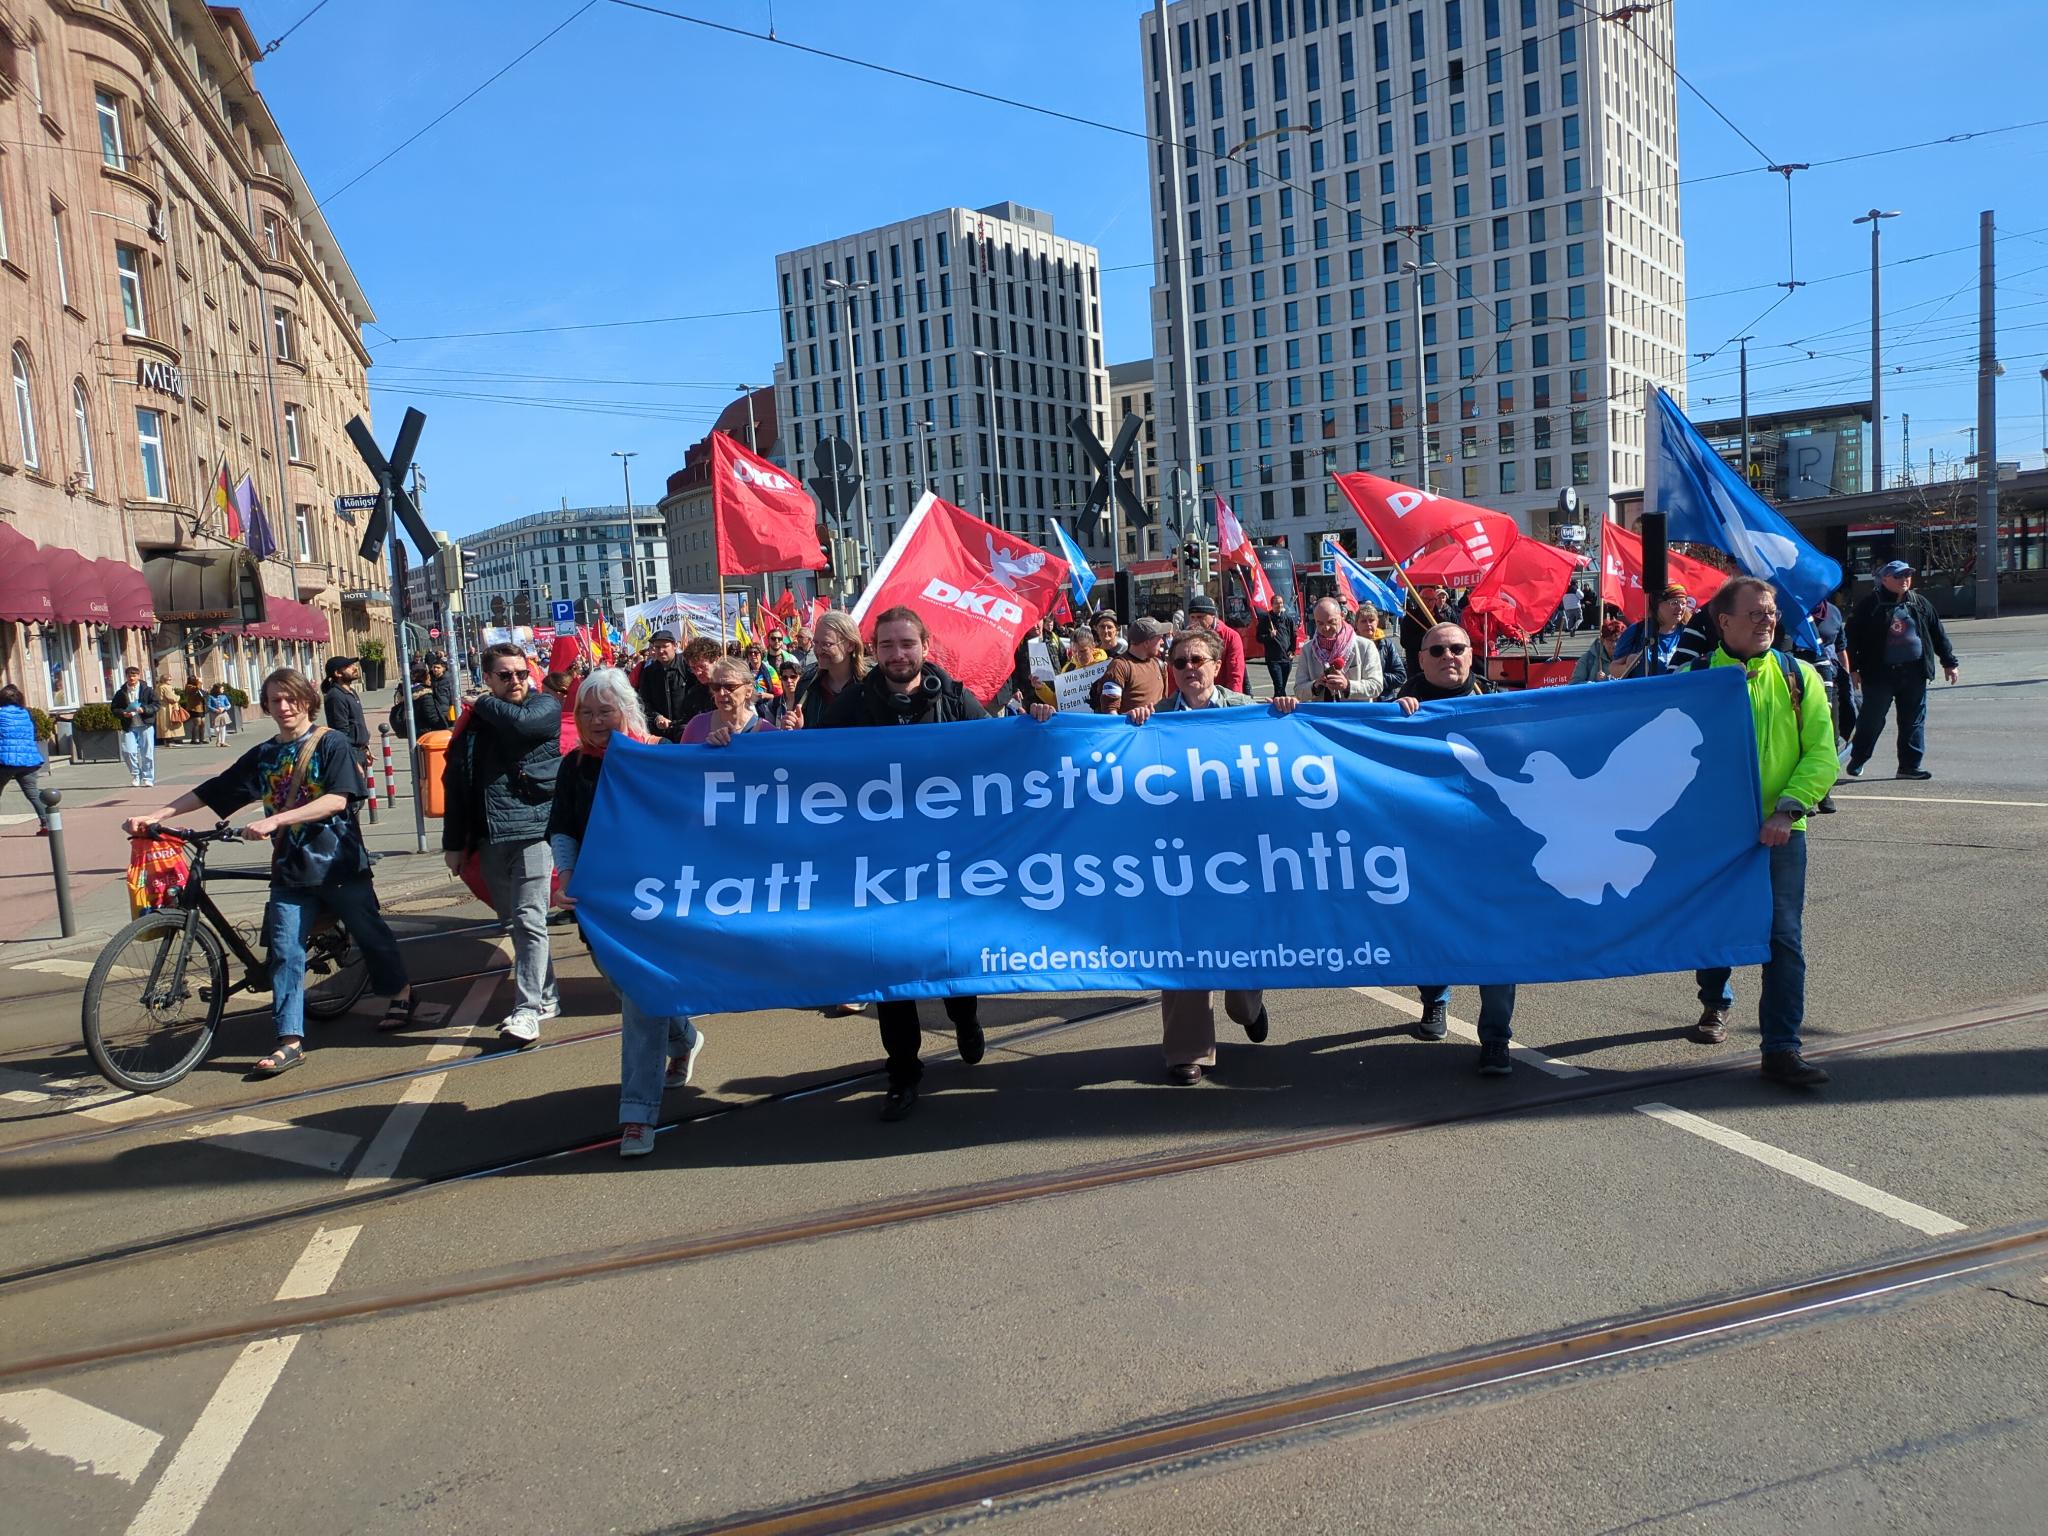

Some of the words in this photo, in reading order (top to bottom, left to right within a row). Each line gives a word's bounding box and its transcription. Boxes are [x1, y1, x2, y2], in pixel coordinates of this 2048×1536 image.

[733, 458, 794, 490] DKP
[1453, 575, 1470, 586] DIE
[344, 591, 368, 600] HOTEL
[921, 577, 1023, 625] DKP
[556, 603, 569, 619] P
[1064, 674, 1078, 683] Wie
[1096, 666, 1105, 674] es
[1543, 675, 1558, 684] Hier
[1558, 674, 1567, 683] ist
[1062, 687, 1078, 697] dem
[1059, 699, 1081, 711] Ersten
[702, 741, 1341, 827] Friedenstüchtig
[631, 860, 820, 921] statt
[853, 829, 1411, 911] kriegssüchtig
[980, 942, 1392, 974] friedensforum-nuernberg.de
